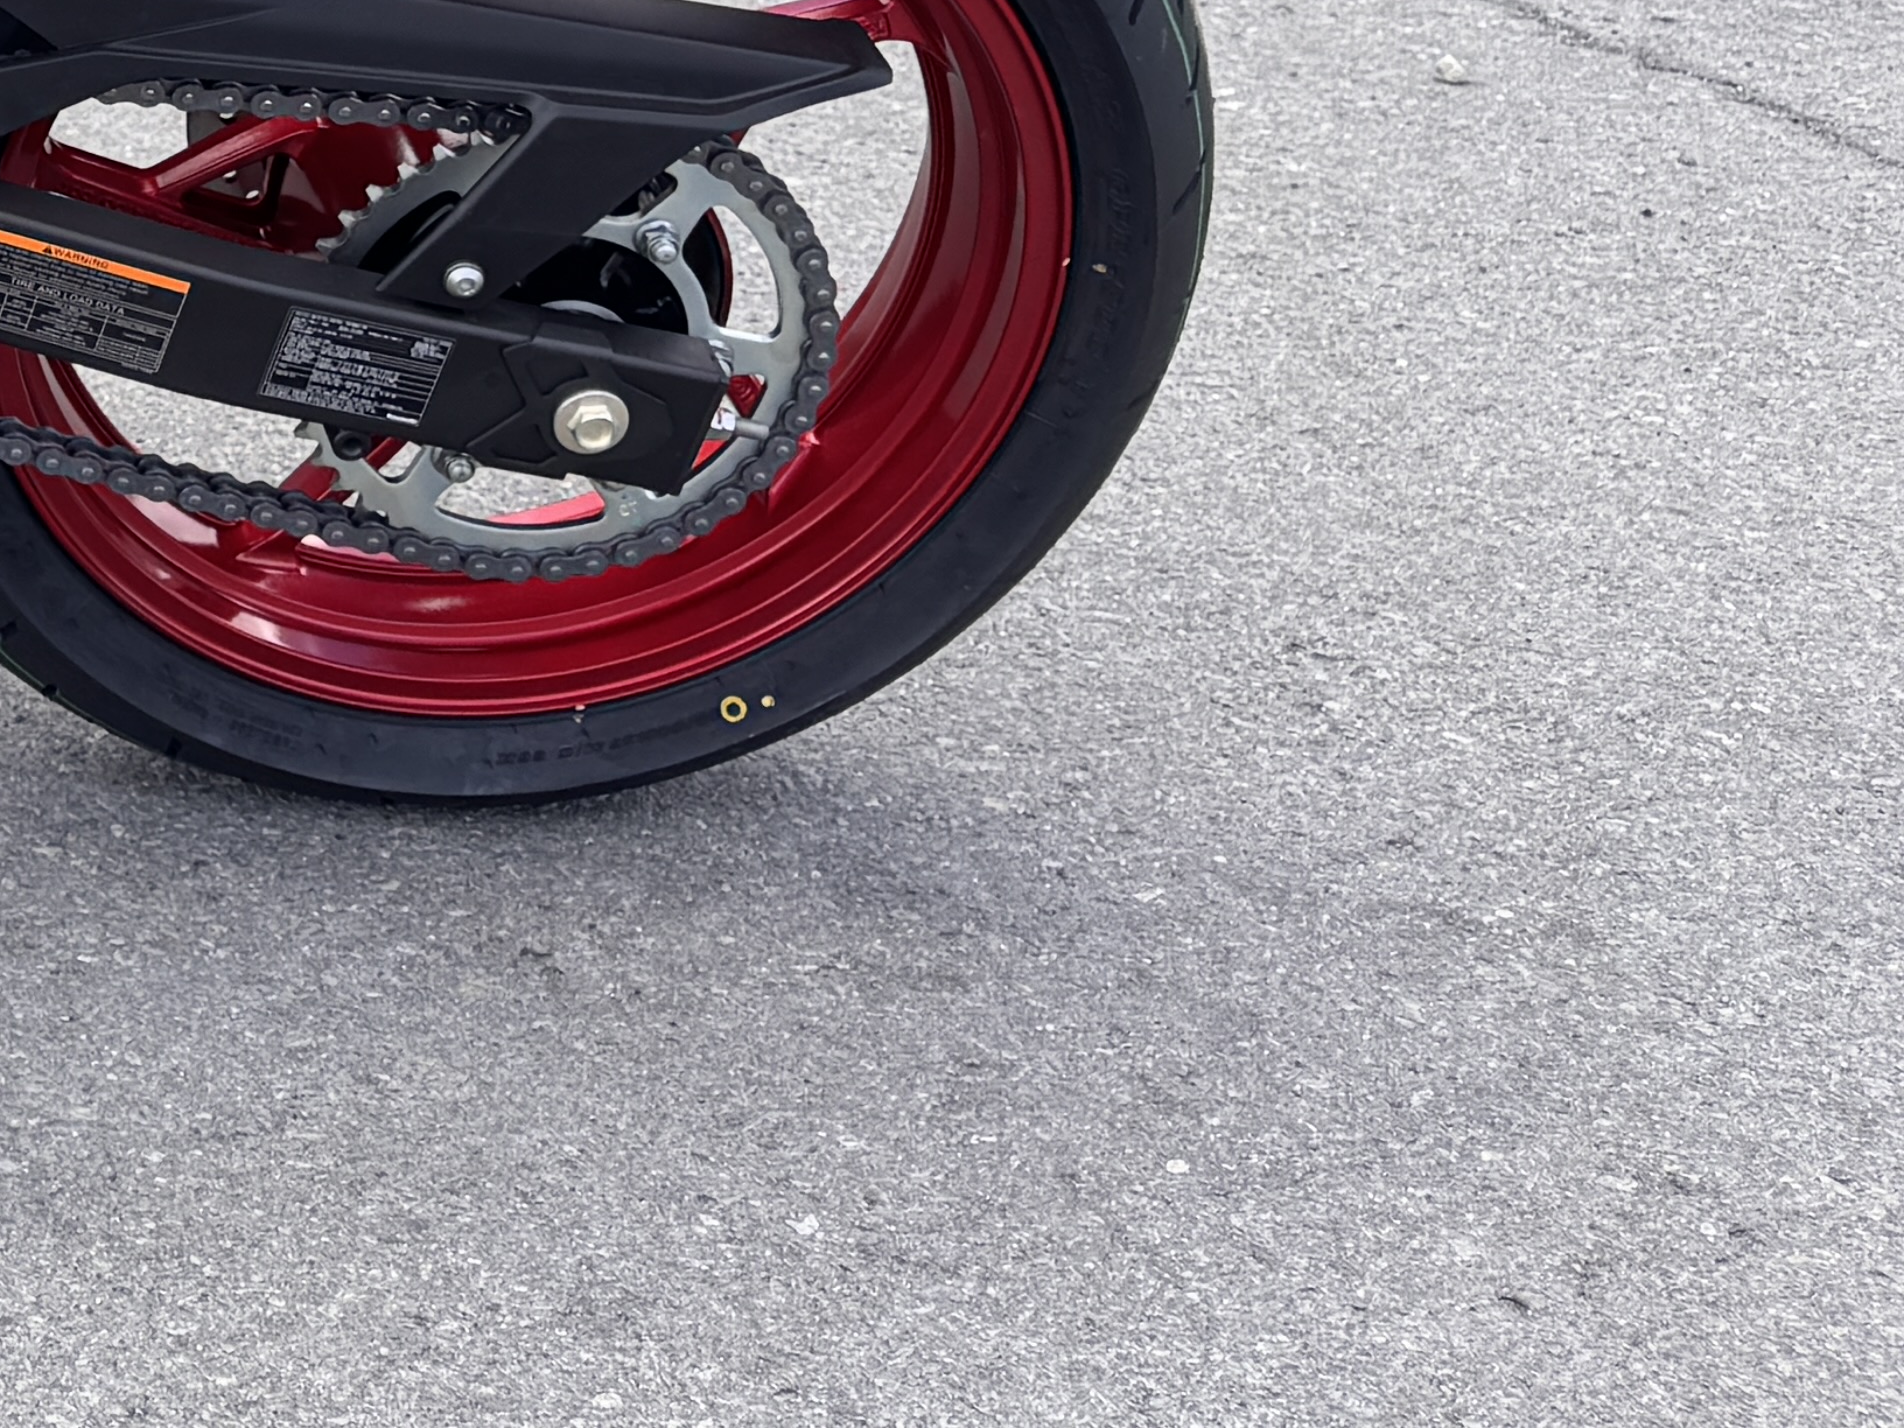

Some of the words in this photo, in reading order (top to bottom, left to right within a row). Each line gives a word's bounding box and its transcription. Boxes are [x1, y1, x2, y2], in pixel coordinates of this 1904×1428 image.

[54, 247, 110, 269] WARNING
[11, 276, 34, 290] TIRE
[38, 285, 63, 299] AND
[64, 292, 93, 306] LOAD
[96, 300, 125, 315] DATA
